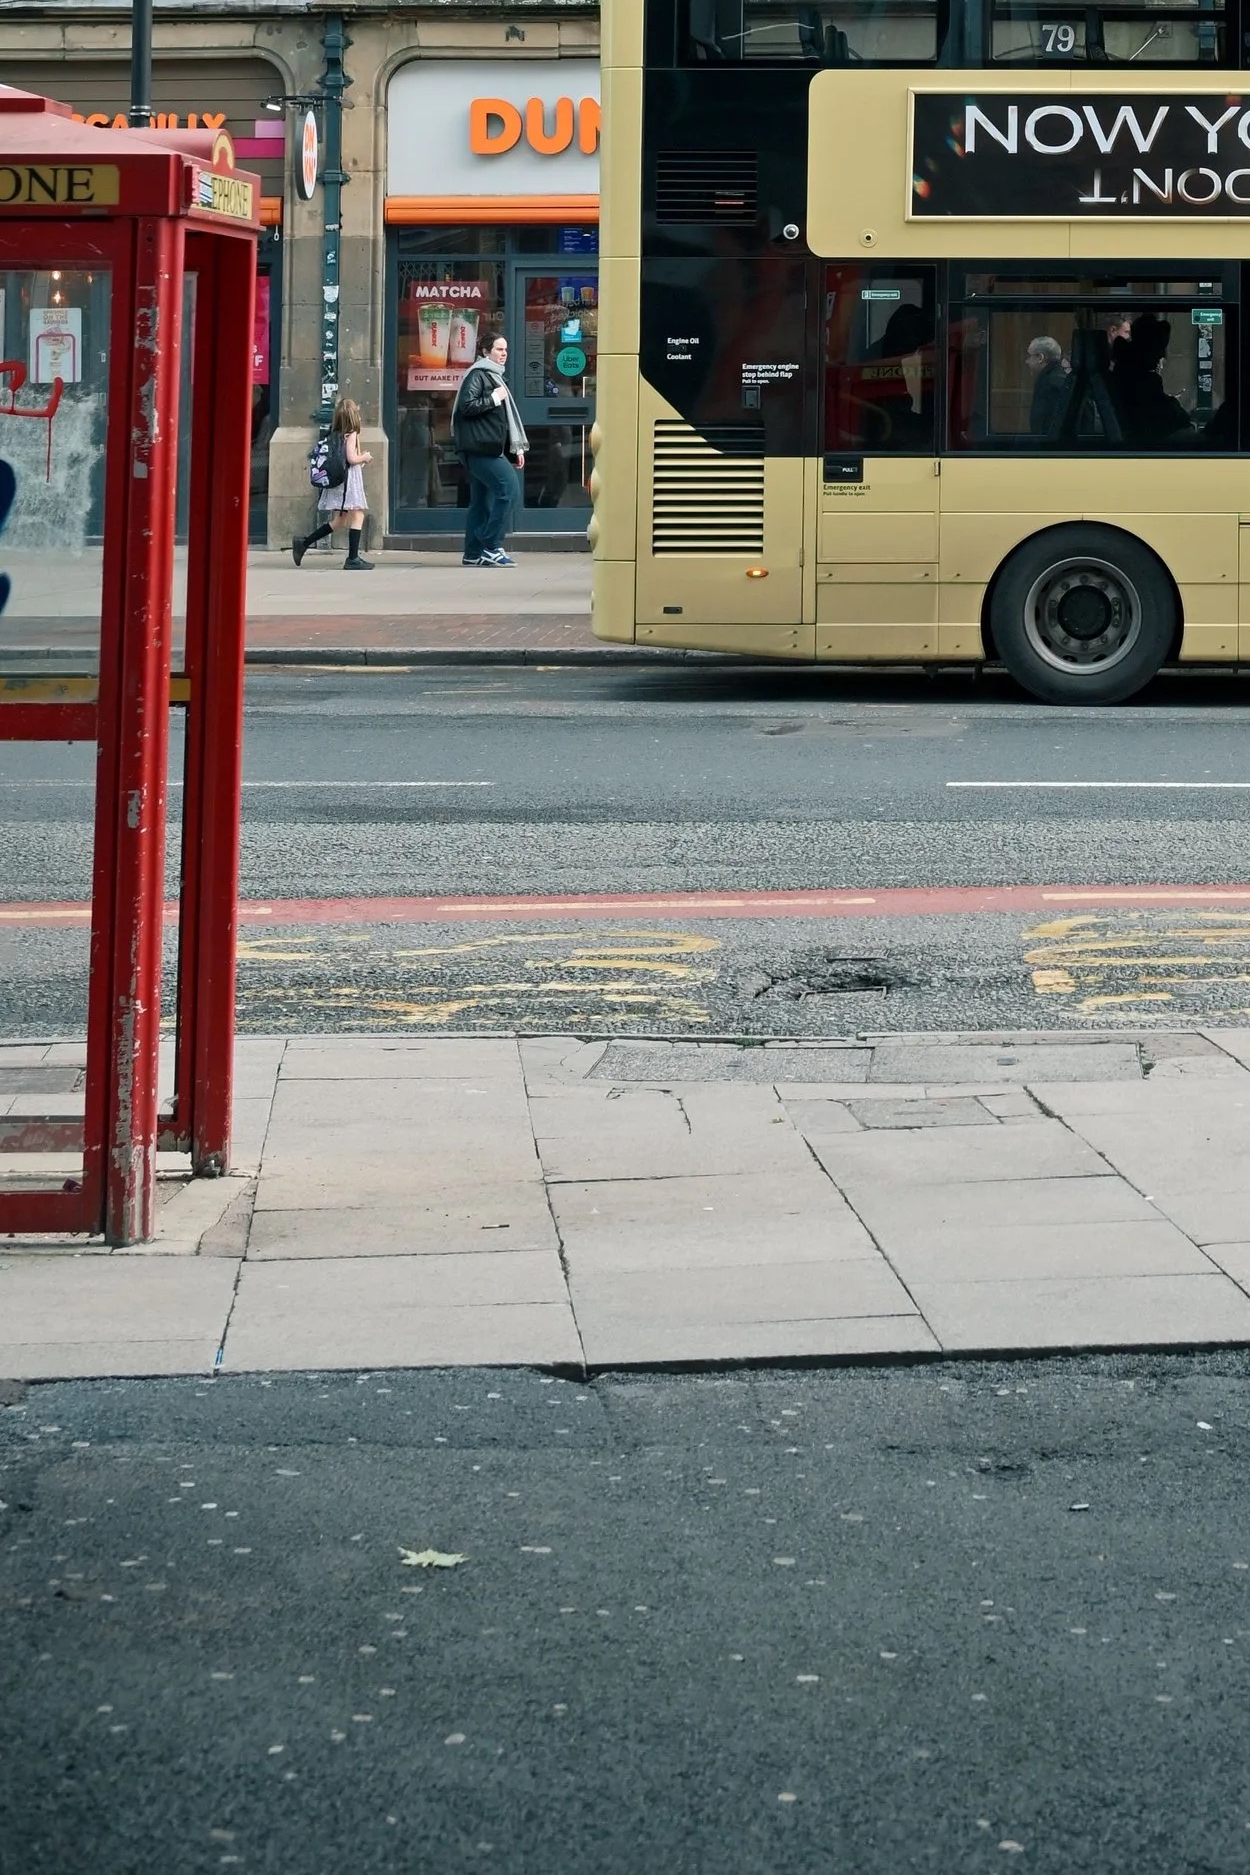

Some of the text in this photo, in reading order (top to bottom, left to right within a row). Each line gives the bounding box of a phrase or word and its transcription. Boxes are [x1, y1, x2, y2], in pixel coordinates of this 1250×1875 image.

[1042, 24, 1075, 52] 79
[965, 105, 1170, 154] NOW
[416, 286, 481, 298] MATCHA
[667, 337, 689, 345] Engine
[742, 363, 800, 371] Emergency engine
[780, 371, 793, 379] flap
[823, 484, 857, 492] Emergency
